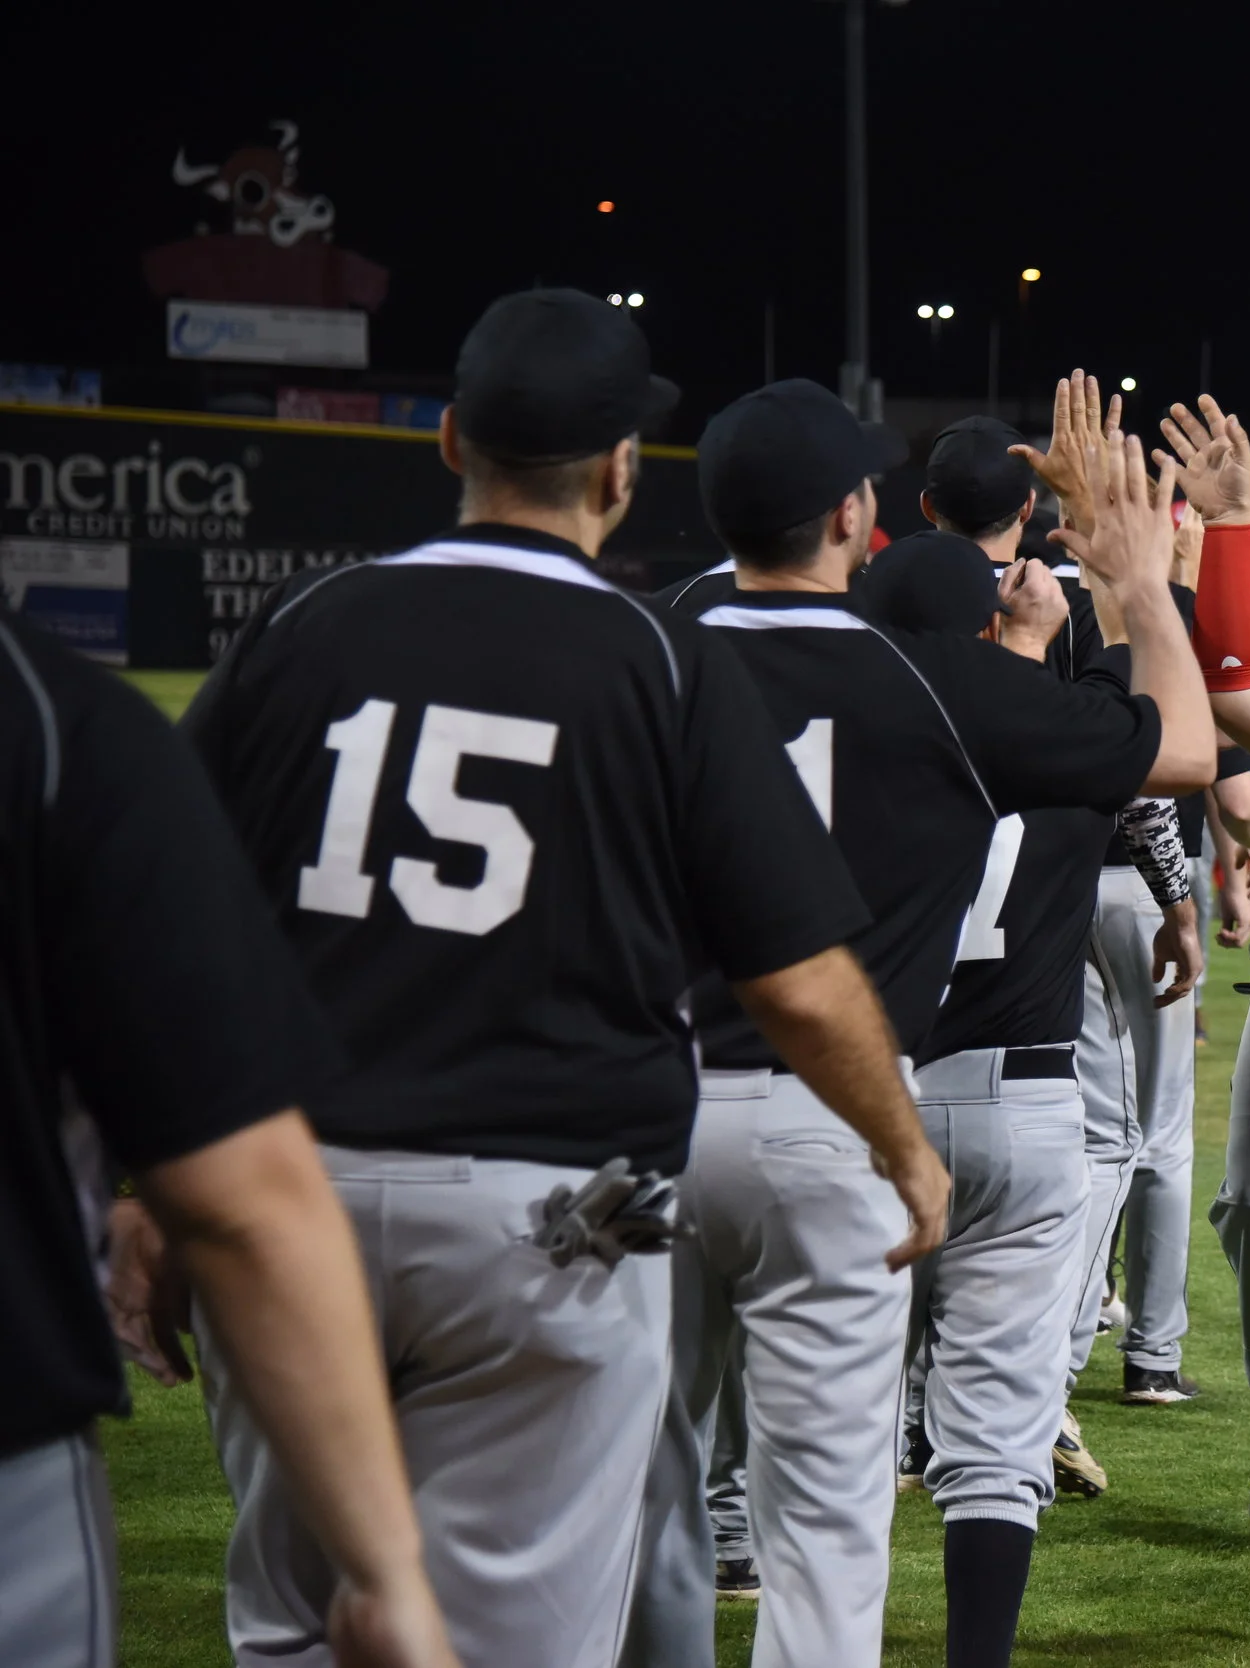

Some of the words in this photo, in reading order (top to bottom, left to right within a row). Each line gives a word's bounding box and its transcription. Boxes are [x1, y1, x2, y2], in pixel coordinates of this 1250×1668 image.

[26, 512, 135, 538] CREDIT
[147, 513, 246, 541] UNION
[297, 698, 560, 936] 15
